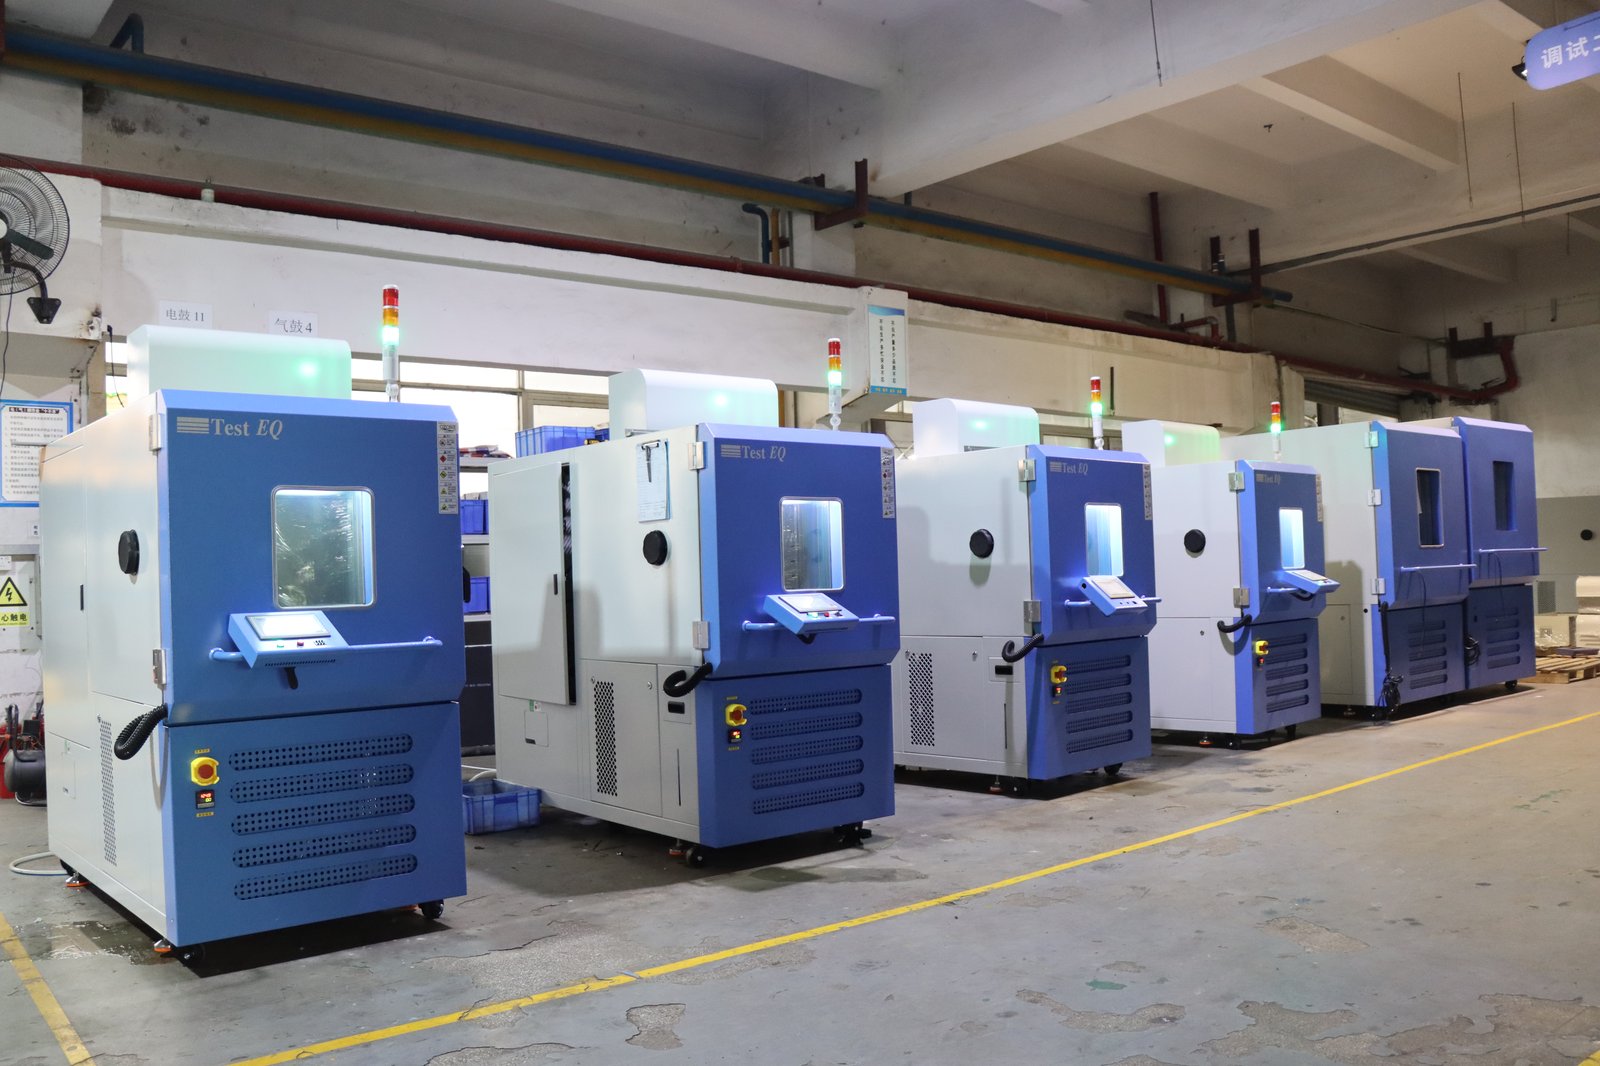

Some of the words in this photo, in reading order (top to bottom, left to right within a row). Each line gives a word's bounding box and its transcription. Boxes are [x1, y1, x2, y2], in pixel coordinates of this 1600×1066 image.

[211, 418, 250, 437] Test
[256, 419, 283, 440] EQ
[742, 445, 766, 460] Test
[770, 446, 786, 462] EQ
[1062, 462, 1077, 474] Test
[1078, 462, 1088, 475] EQ
